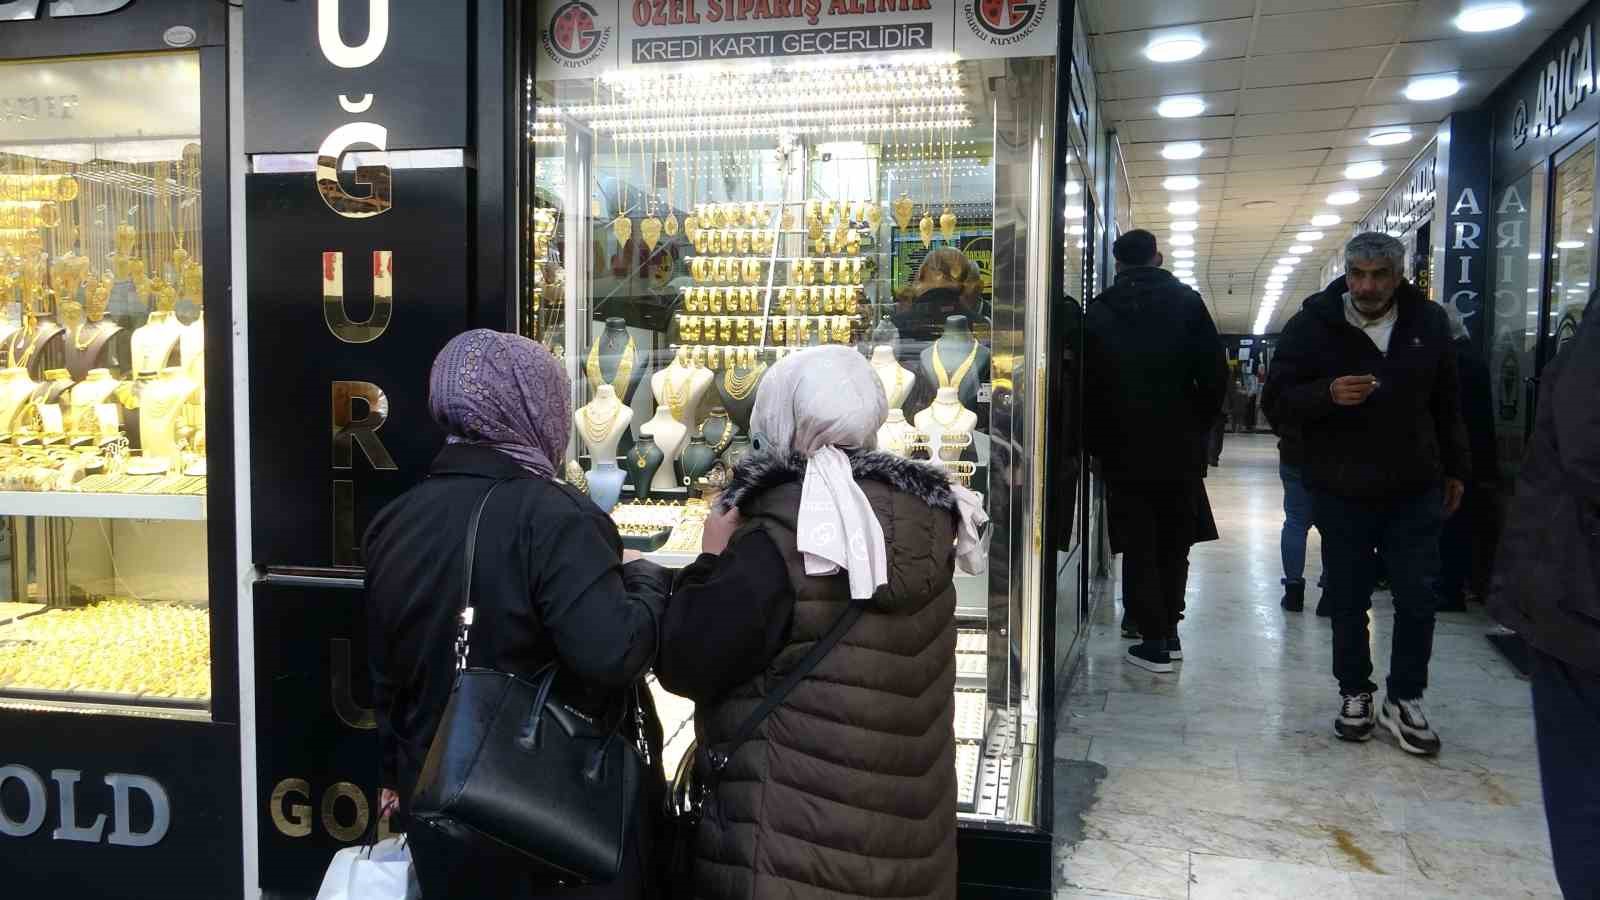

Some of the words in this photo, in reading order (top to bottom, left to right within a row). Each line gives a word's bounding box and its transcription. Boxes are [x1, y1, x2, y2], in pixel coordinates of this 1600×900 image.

[636, 39, 703, 61] KREDİ
[709, 35, 775, 57] KARTI
[782, 25, 926, 54] GEÇERLİDİR
[1533, 23, 1597, 136] ARICA
[1450, 187, 1483, 337] ARIC
